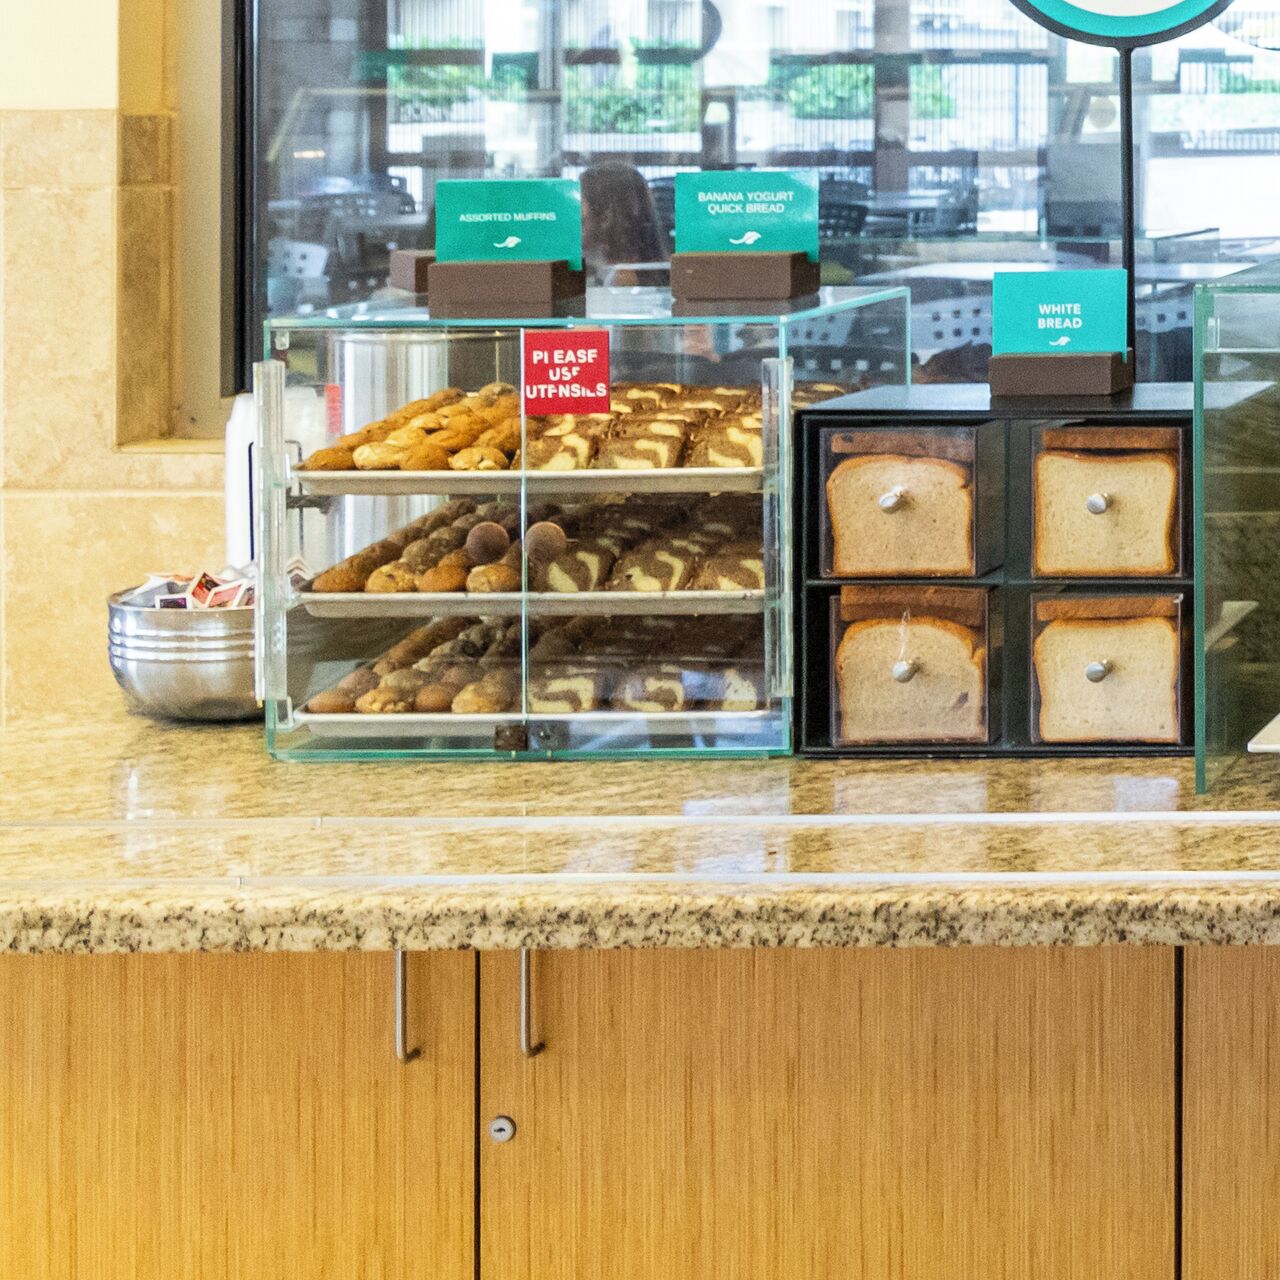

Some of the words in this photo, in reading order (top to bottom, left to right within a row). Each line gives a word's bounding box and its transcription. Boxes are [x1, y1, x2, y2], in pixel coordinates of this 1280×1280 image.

[698, 191, 744, 202] BANANA
[746, 191, 794, 202] YOGURT
[707, 203, 743, 215] QUICK
[745, 203, 785, 214] BREAD
[459, 213, 512, 222] ASSORTED
[513, 211, 557, 222] MUFFINS
[1038, 303, 1082, 315] WHITE
[1037, 317, 1083, 329] BREAD
